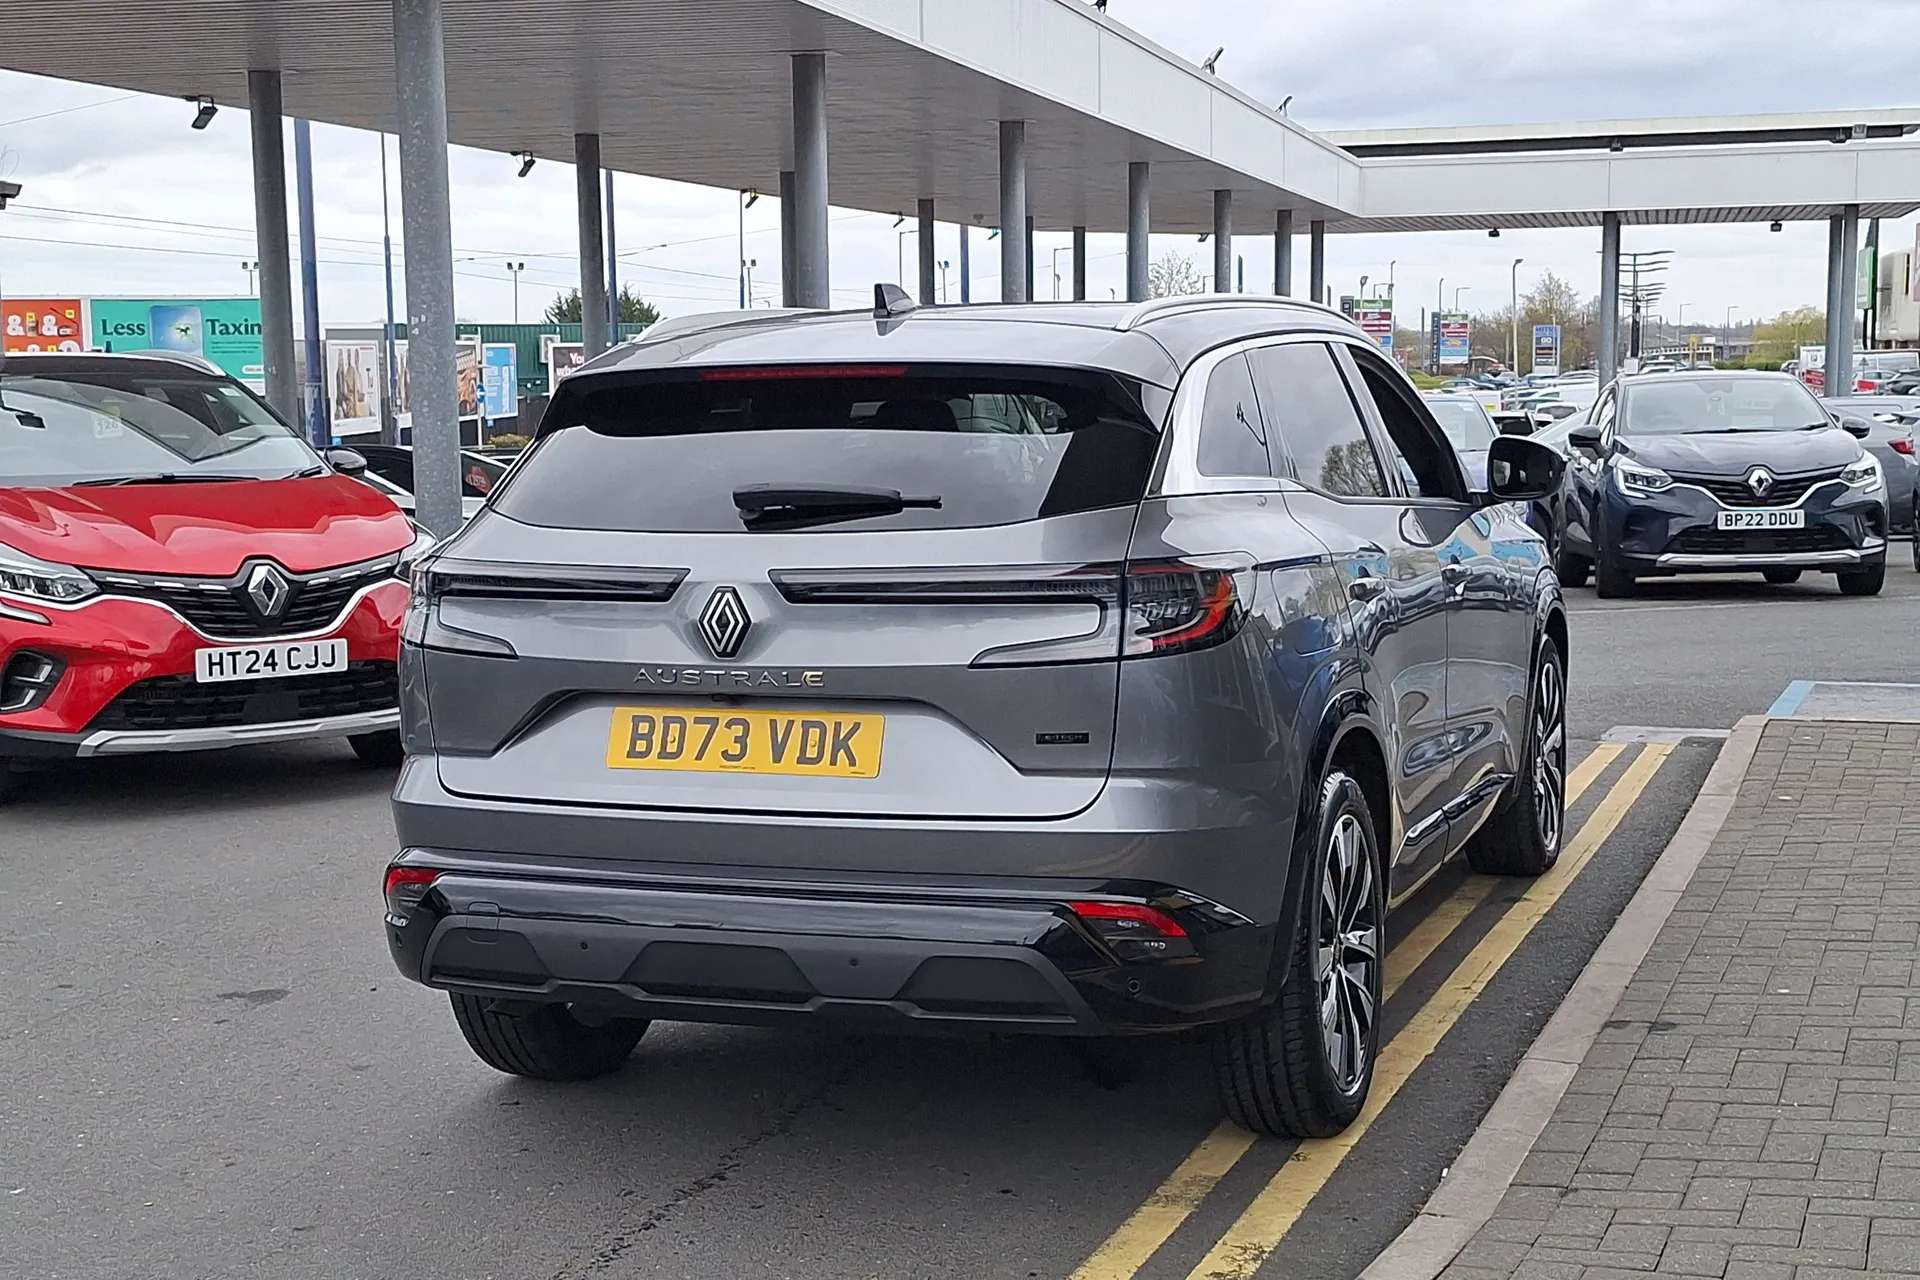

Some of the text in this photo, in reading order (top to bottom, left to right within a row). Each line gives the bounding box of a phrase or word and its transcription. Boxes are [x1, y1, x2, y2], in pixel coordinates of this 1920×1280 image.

[102, 319, 146, 336] Less
[1724, 511, 1798, 527] BP22 DDU
[207, 643, 336, 677] HT24 CJJ
[633, 667, 824, 687] AUSTRALE
[626, 714, 861, 767] BD73 VDK
